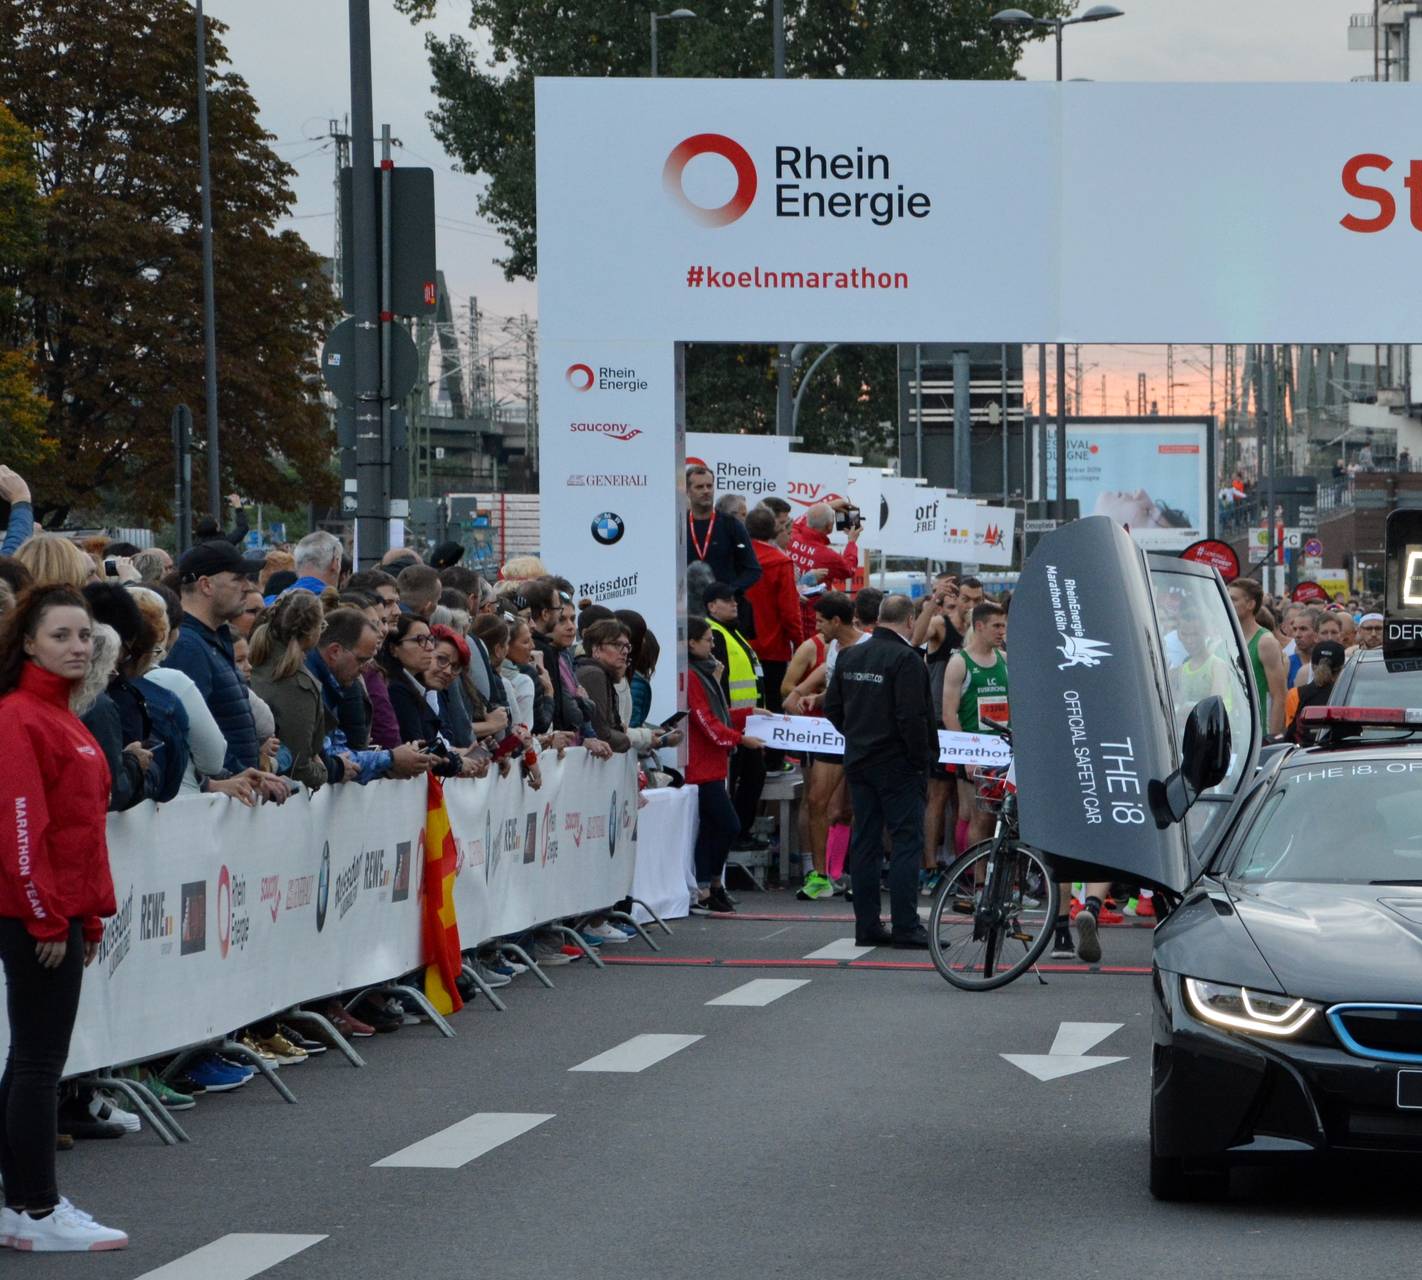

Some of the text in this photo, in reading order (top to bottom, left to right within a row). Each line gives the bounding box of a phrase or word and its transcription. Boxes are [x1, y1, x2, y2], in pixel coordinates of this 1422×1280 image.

[775, 145, 890, 181] Rhein
[775, 184, 932, 226] Energie
[685, 265, 909, 290] #koelnmarathon
[599, 367, 636, 379] Rhein
[599, 378, 648, 393] Energie
[570, 422, 628, 434] saucony
[586, 474, 648, 487] GENERALI
[715, 461, 762, 477] Rhein
[715, 476, 777, 493] Energie
[913, 519, 937, 534] FREI
[791, 540, 816, 556] RUN
[578, 571, 639, 598] Reissdorf
[1045, 565, 1068, 631] Marathon Köln
[1064, 578, 1085, 638] RheinEnergie
[1063, 690, 1102, 824] OFFICIAL SAFETY CAR
[1100, 736, 1145, 824] THE i8
[1289, 766, 1344, 785] THE
[1351, 764, 1378, 776] i8.
[15, 796, 46, 919] MARATHON TEAM
[363, 849, 385, 890] REWE
[140, 891, 165, 941] REWE
